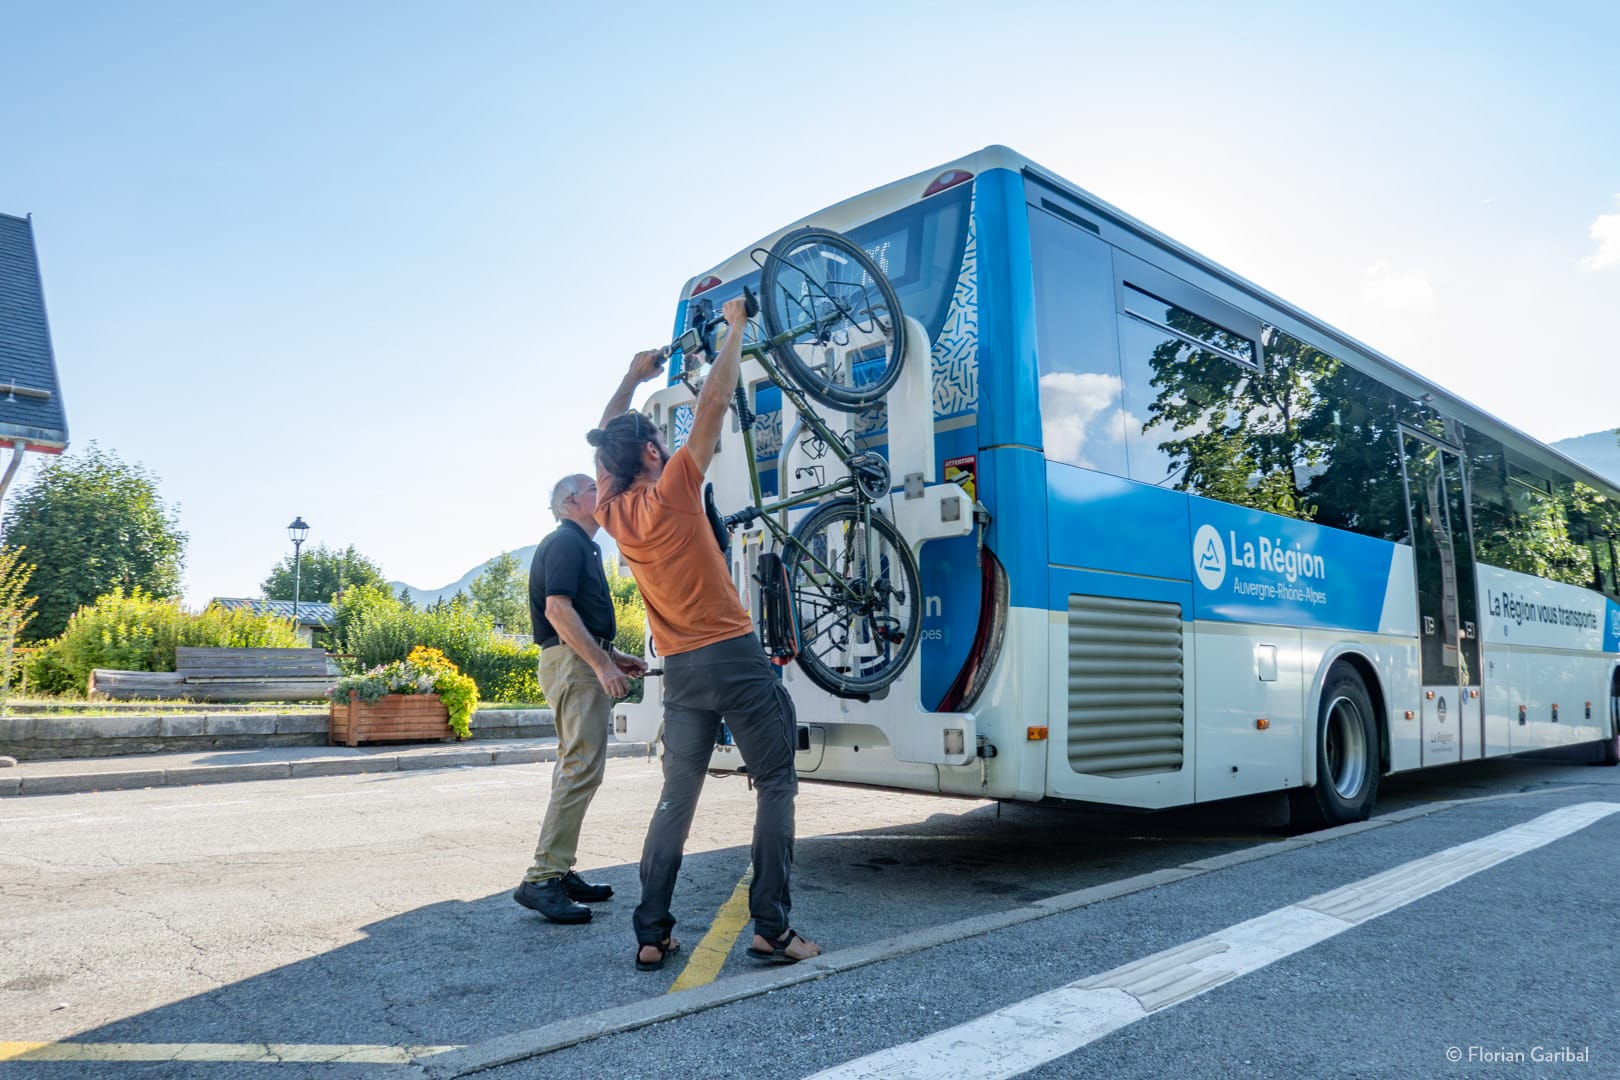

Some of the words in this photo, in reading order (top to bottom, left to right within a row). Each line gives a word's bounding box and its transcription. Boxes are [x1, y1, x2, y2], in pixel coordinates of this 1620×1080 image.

[1230, 530, 1255, 568] La
[1259, 536, 1326, 583] Région
[1233, 577, 1327, 605] Auvergne-Rhône-Alpes
[1488, 589, 1501, 617] La
[1502, 592, 1536, 626] Région
[1536, 604, 1558, 624] vous
[1558, 605, 1597, 632] transporte
